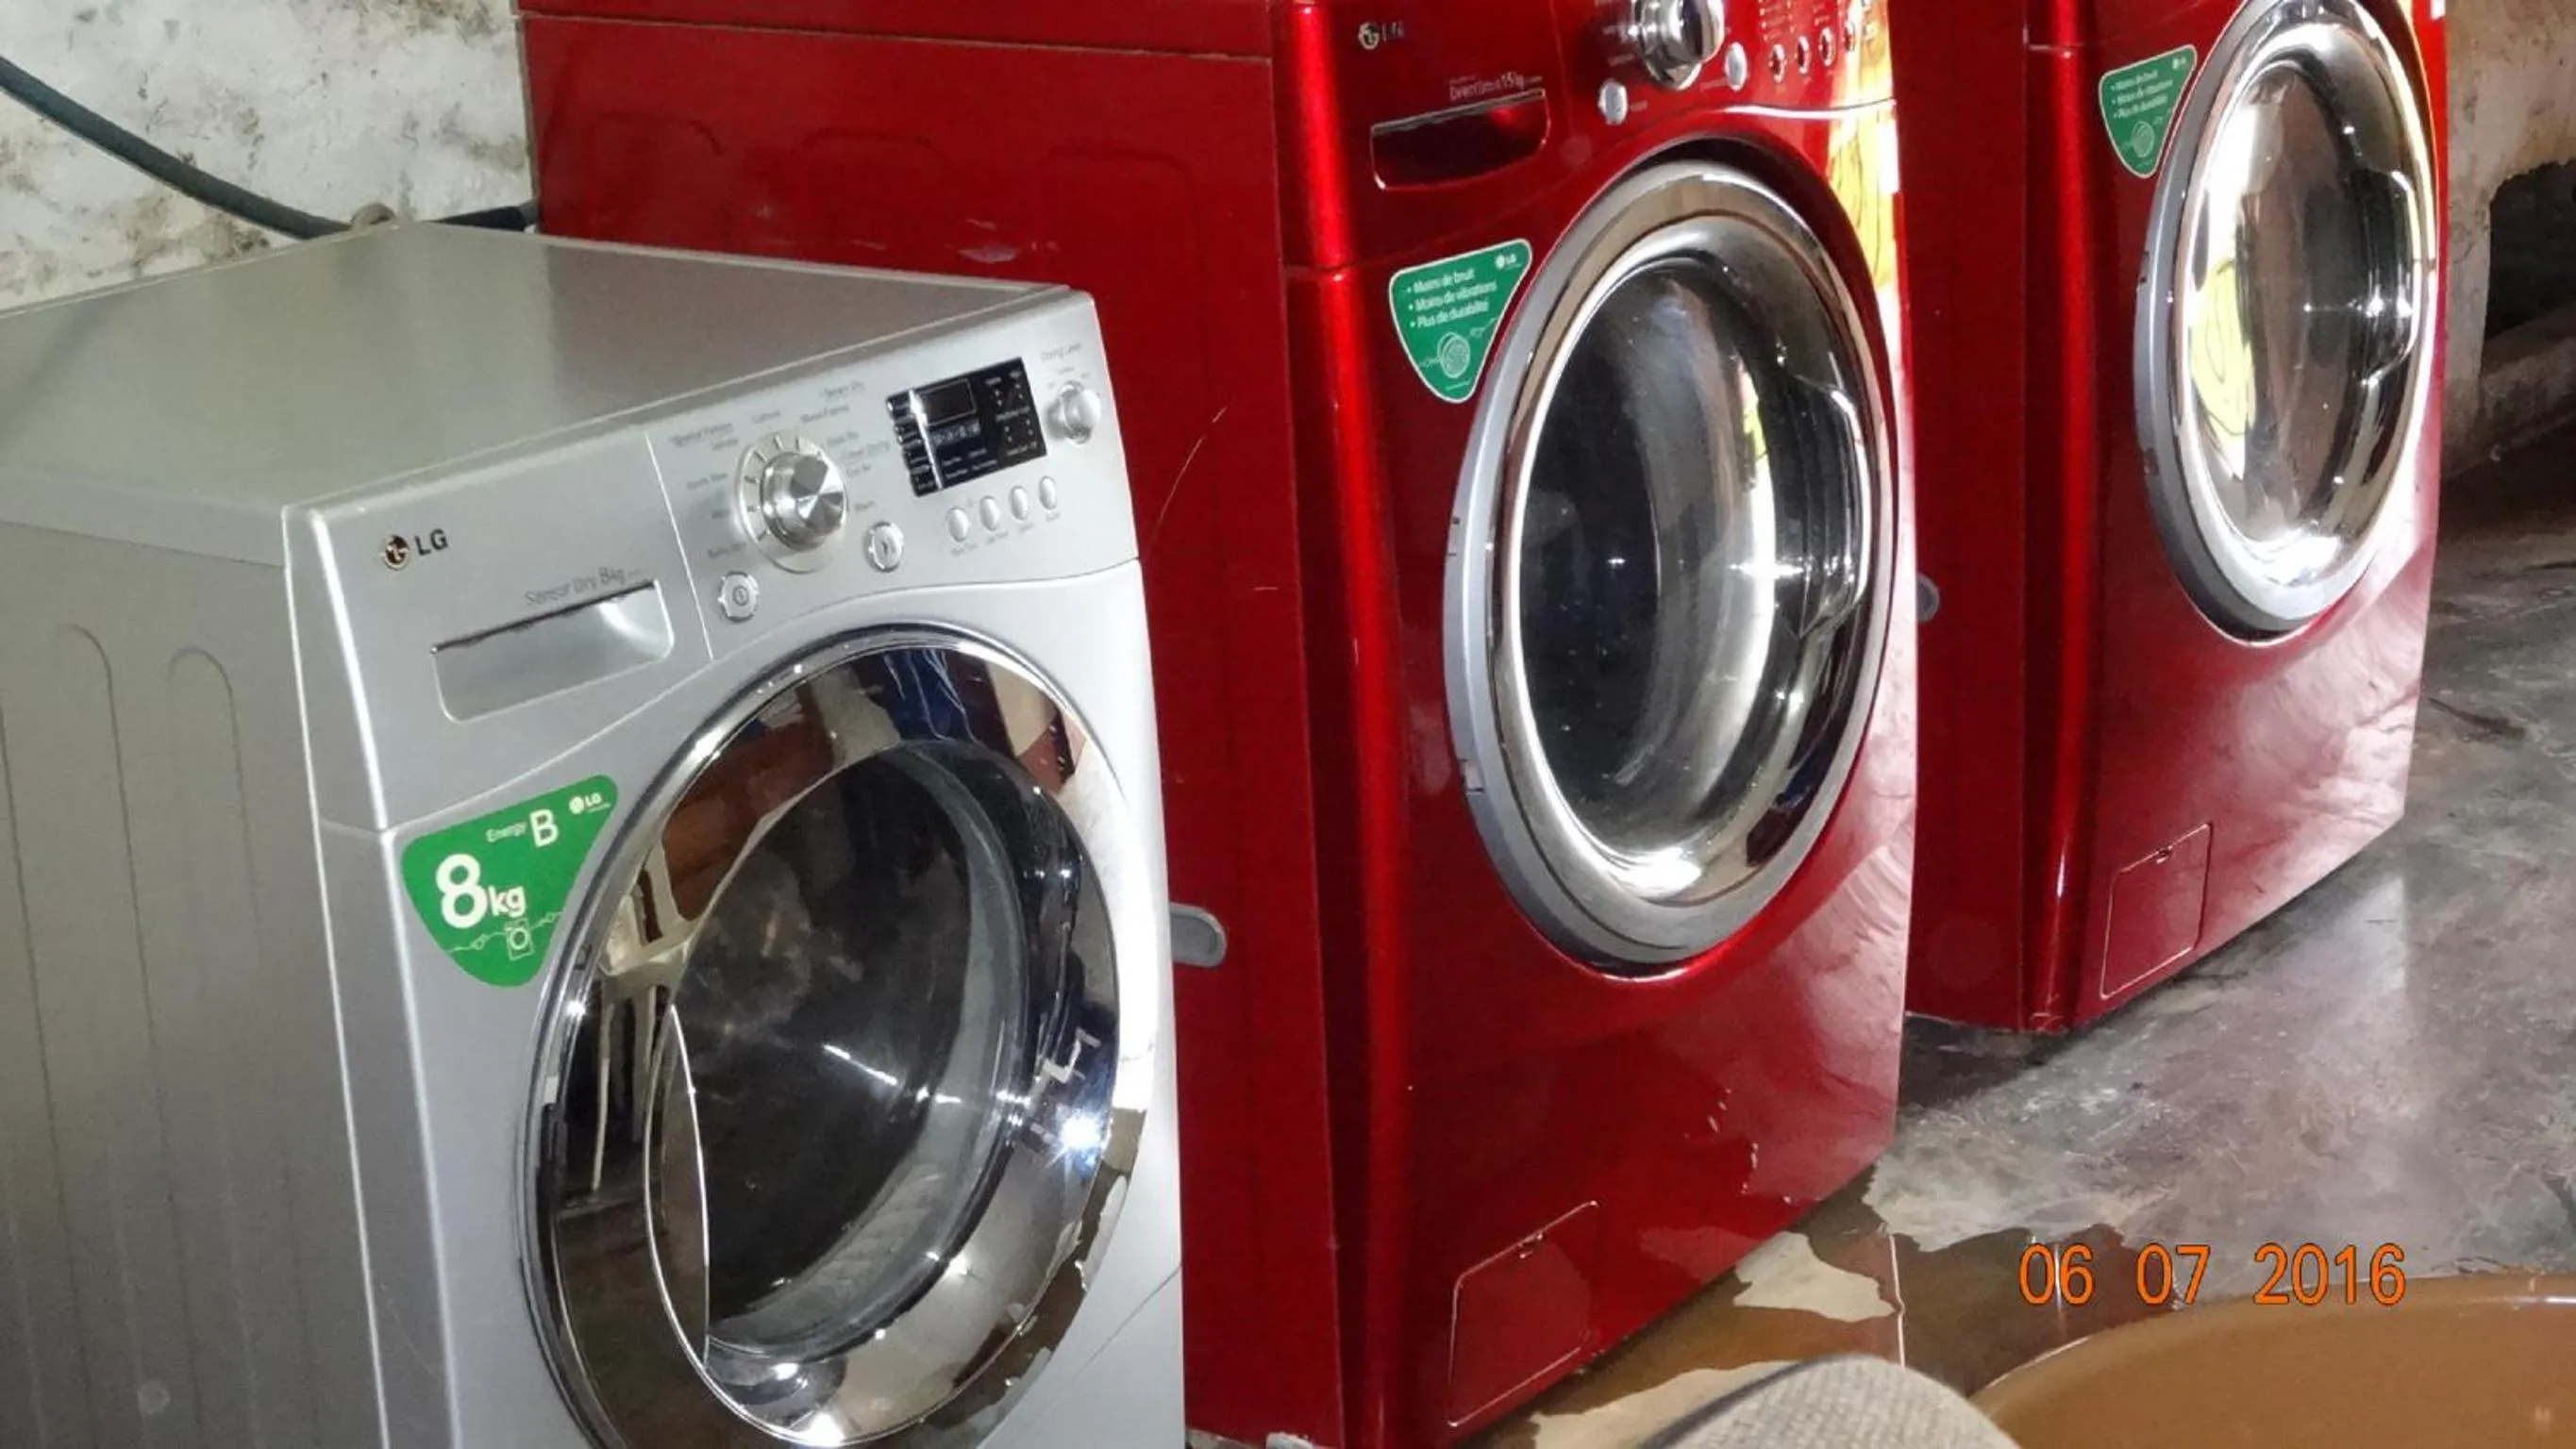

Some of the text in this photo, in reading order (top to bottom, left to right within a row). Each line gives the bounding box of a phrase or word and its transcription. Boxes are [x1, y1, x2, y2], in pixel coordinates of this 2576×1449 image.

[414, 528, 449, 558] LG
[485, 808, 559, 849] Energy B
